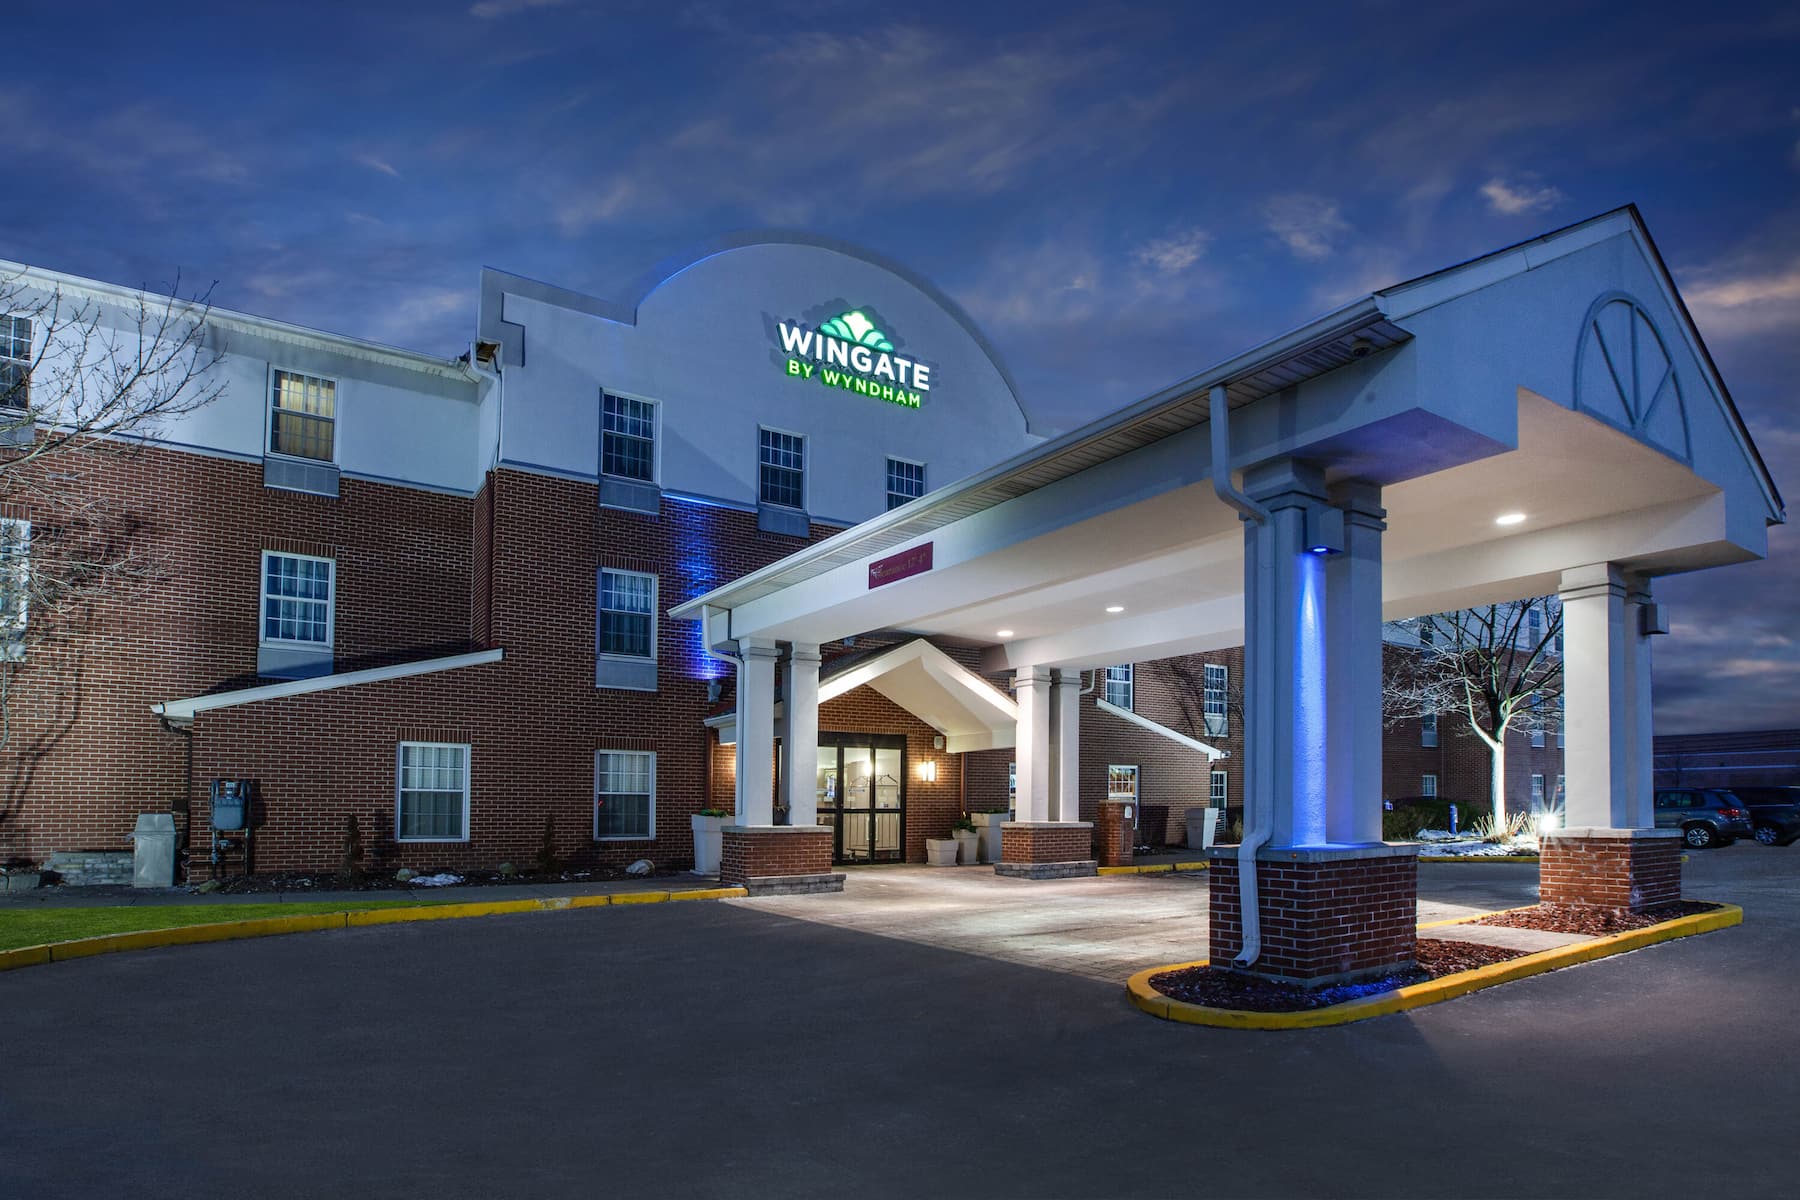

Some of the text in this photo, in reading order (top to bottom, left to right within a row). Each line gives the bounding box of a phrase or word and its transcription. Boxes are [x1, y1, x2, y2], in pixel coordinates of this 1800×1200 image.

[778, 322, 931, 391] WINGATE
[788, 358, 921, 408] BY WYNDHAM
